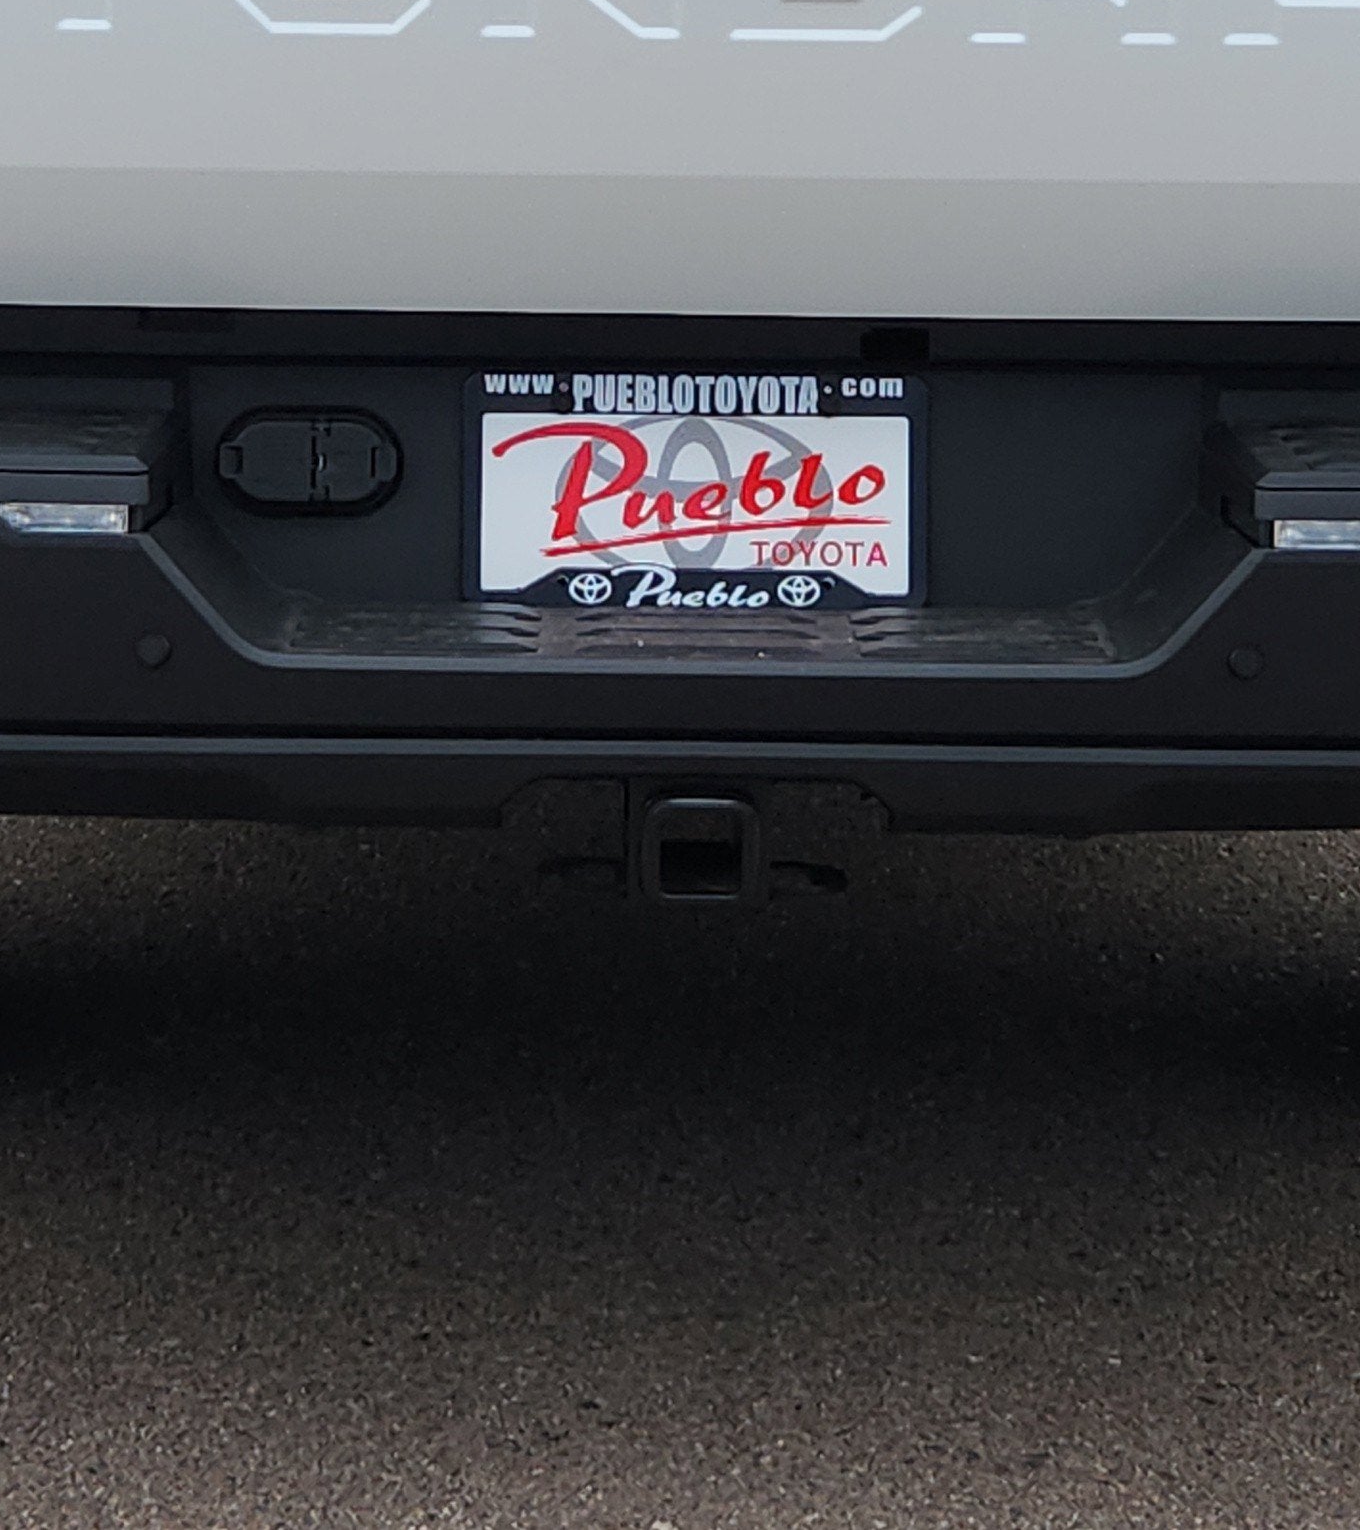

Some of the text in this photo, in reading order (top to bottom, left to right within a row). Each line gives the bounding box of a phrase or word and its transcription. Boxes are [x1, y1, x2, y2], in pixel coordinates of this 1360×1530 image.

[572, 373, 819, 414] PUEBLOTOYOTA
[492, 421, 886, 541] Pueblo
[750, 540, 888, 567] TOYOTA
[611, 563, 771, 608] Pueblo
